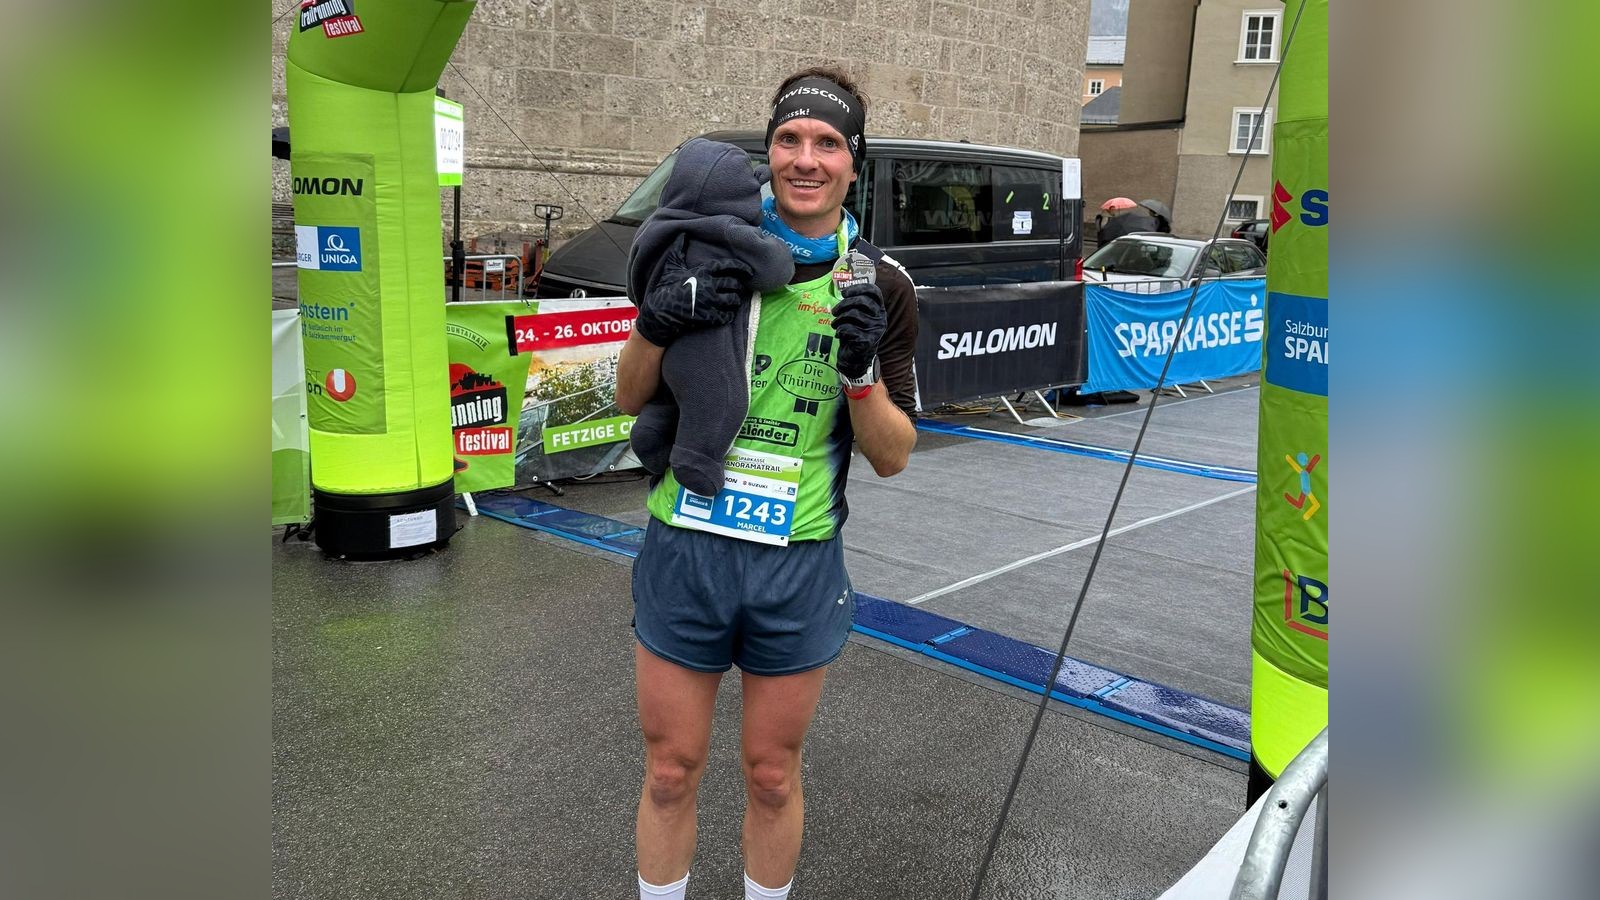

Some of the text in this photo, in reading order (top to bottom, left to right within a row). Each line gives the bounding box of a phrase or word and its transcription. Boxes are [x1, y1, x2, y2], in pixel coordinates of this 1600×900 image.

[324, 17, 362, 36] festival
[779, 86, 850, 113] swisscom
[293, 177, 364, 196] OMON
[321, 254, 358, 264] UNIQA
[516, 329, 539, 342] 24.
[554, 325, 577, 339] 26.
[937, 322, 1058, 360] SALOMON
[1114, 310, 1242, 358] SPARKASSE
[803, 363, 824, 378] Die
[781, 373, 840, 395] Thüringer
[460, 429, 510, 452] festival
[552, 426, 615, 447] FETZIGE
[724, 494, 787, 526] 1243
[737, 521, 767, 533] MARCEL
